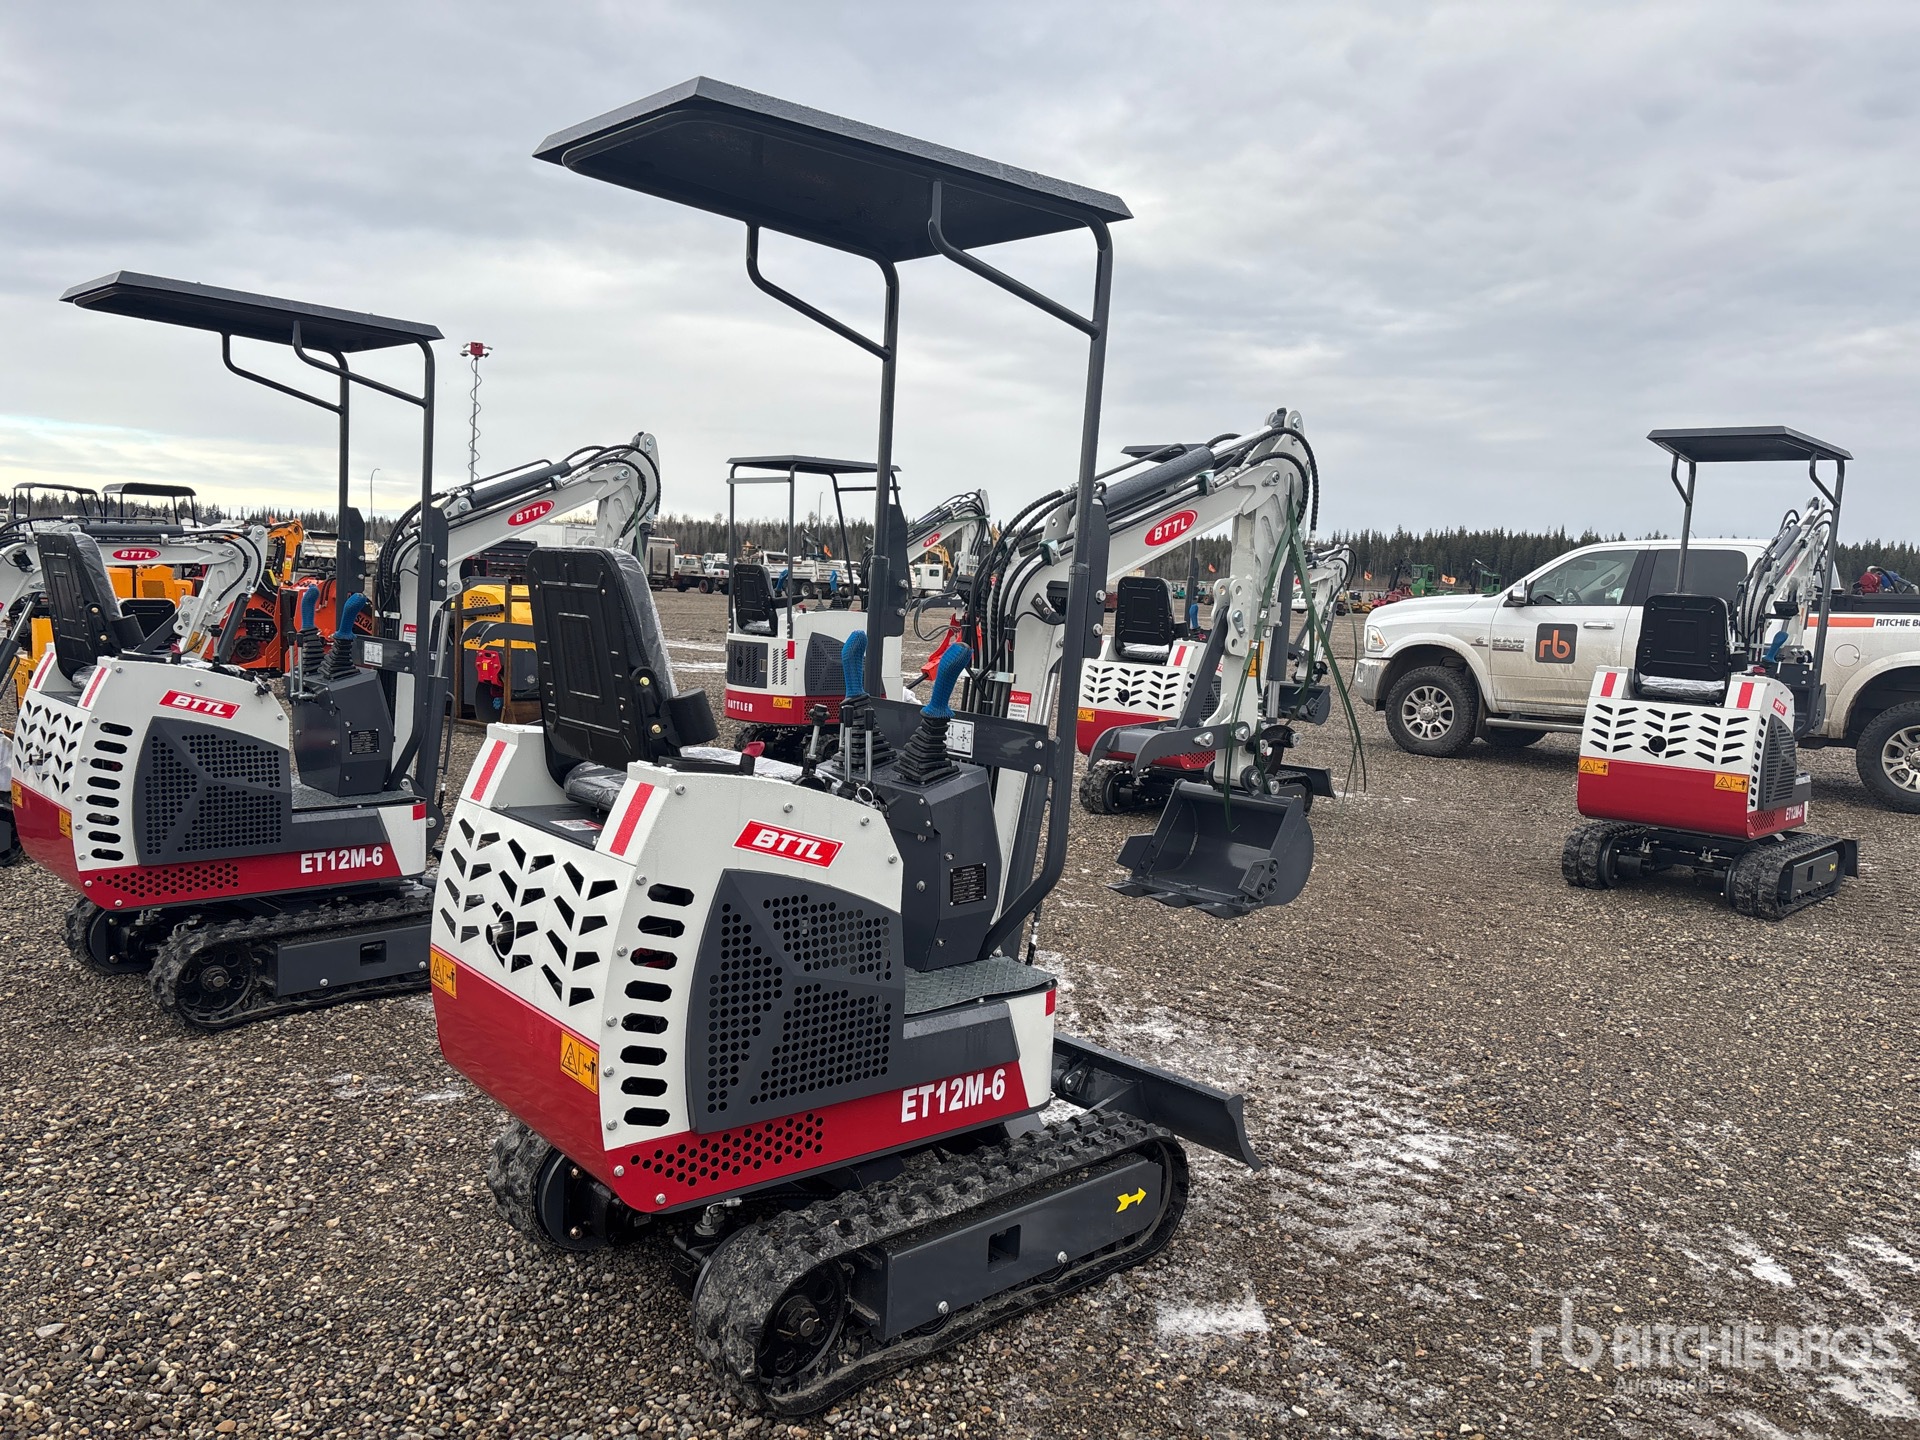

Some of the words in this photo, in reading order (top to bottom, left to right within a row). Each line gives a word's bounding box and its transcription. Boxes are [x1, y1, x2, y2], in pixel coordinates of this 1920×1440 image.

[516, 505, 546, 523] BTTL
[1154, 518, 1188, 541] BTTL
[120, 551, 151, 559] BTTL
[1876, 618, 1911, 627] RITCHIE
[1538, 629, 1571, 659] rb
[171, 694, 226, 715] BTTL
[752, 828, 823, 860] BTTL
[300, 846, 384, 874] ET12M-6
[901, 1068, 1006, 1123] ET12M-6
